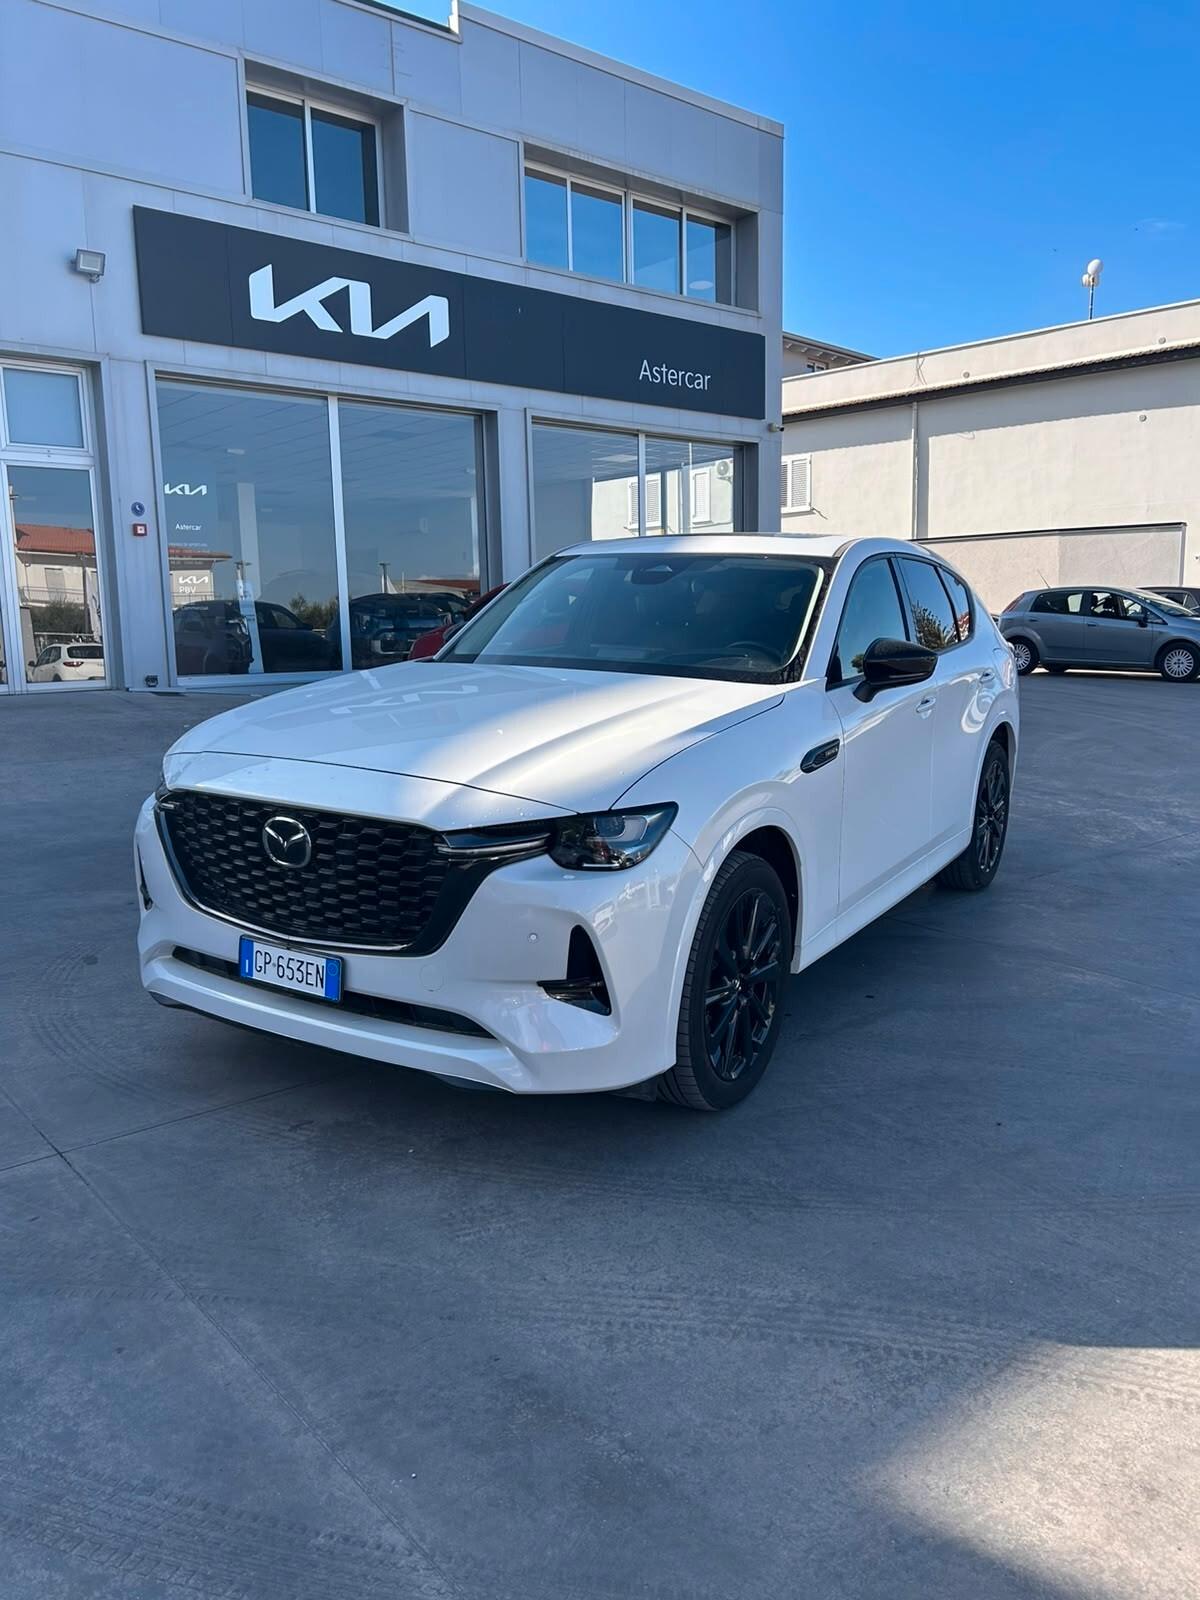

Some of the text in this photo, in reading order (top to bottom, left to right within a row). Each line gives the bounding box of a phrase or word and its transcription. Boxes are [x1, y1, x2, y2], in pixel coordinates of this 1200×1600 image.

[248, 263, 450, 348] KIA
[639, 359, 711, 390] Astercar
[164, 483, 207, 496] KIA
[175, 523, 202, 531] Astercar
